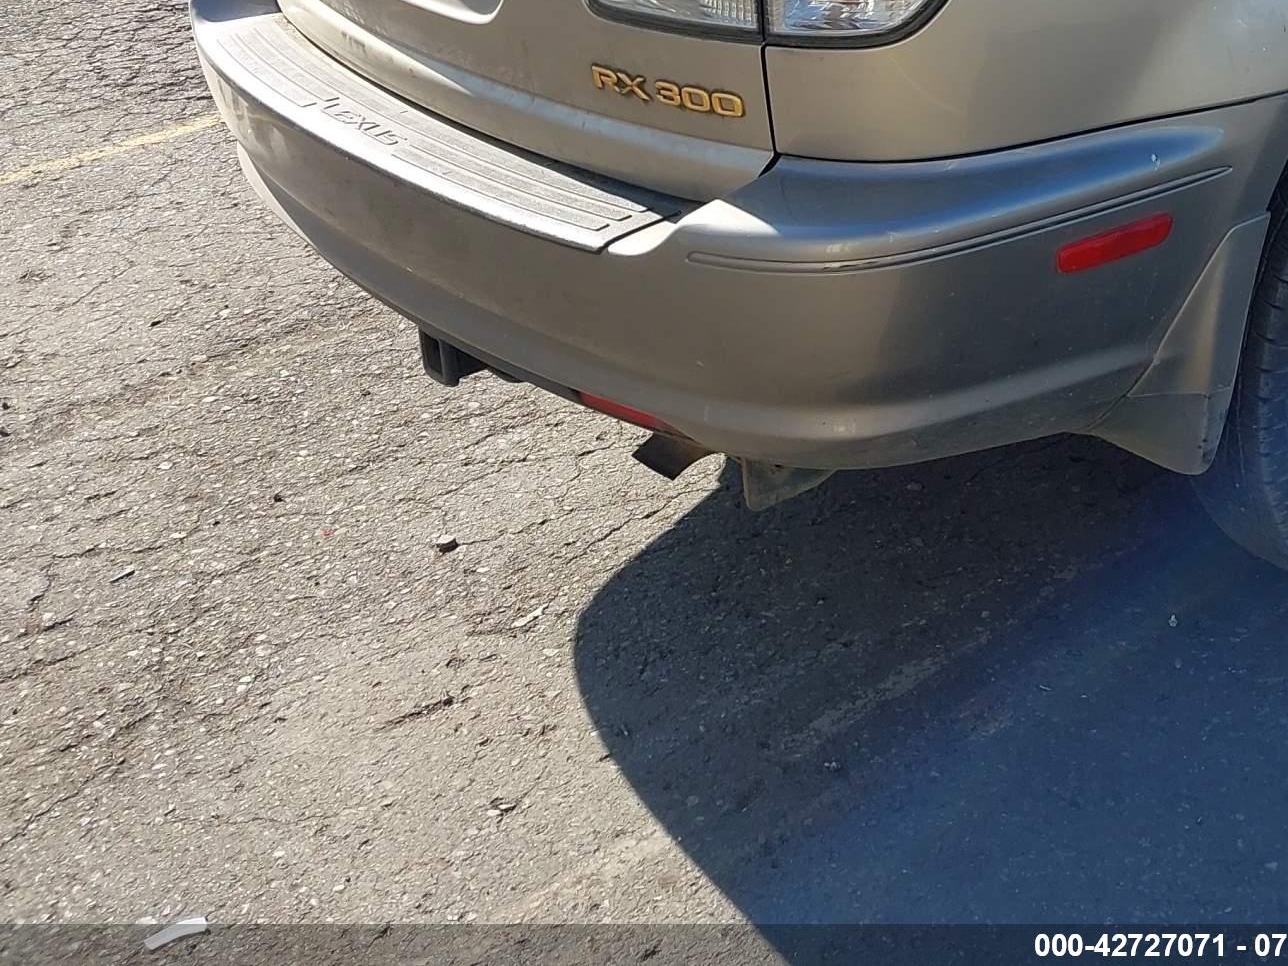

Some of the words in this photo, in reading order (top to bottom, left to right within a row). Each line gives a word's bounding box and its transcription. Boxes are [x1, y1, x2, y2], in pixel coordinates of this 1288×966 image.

[591, 64, 651, 101] RX
[655, 80, 745, 117] 300
[320, 102, 408, 146] LEXUS
